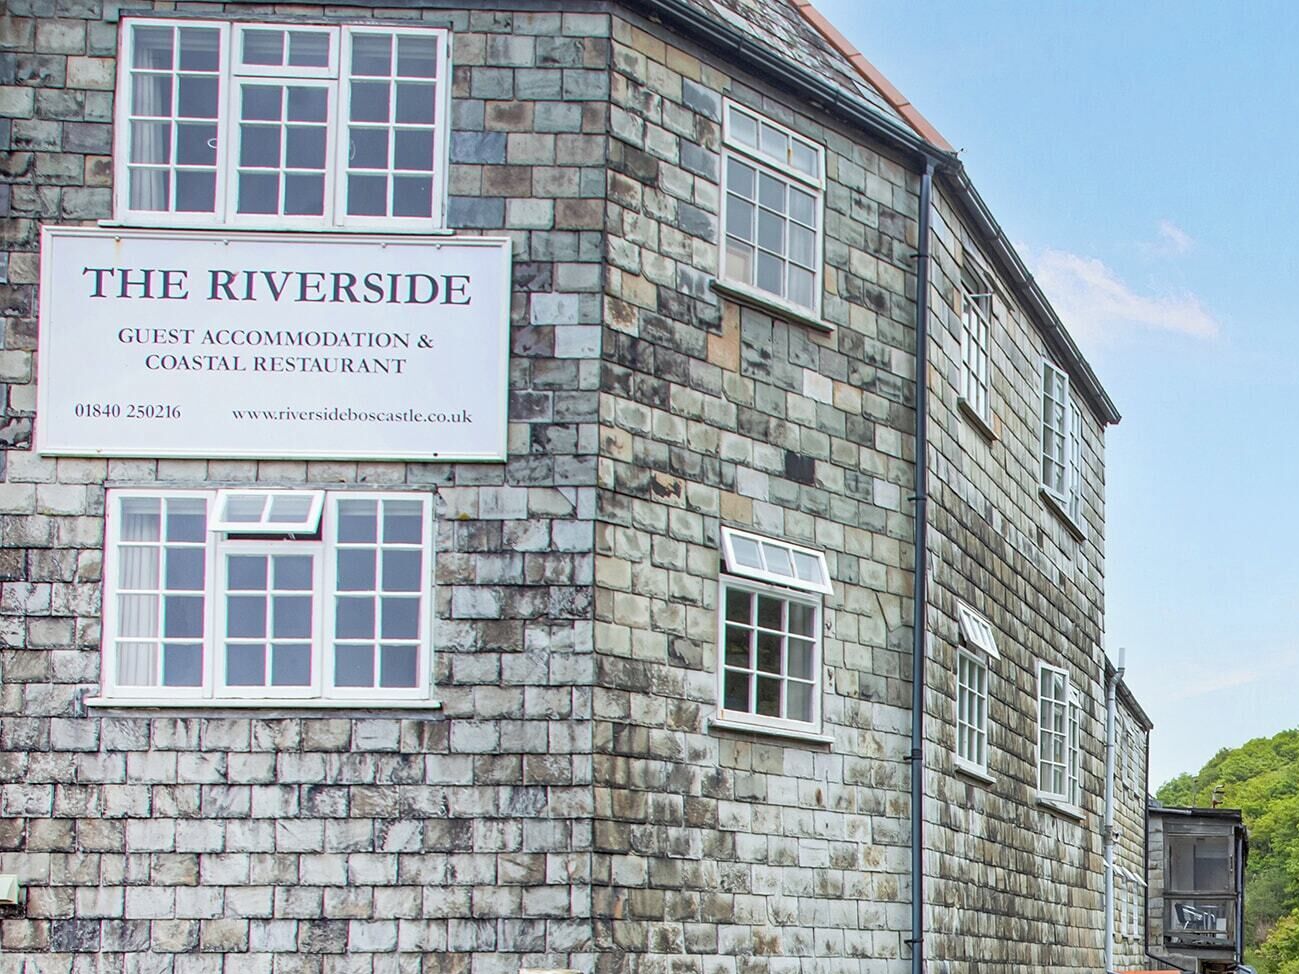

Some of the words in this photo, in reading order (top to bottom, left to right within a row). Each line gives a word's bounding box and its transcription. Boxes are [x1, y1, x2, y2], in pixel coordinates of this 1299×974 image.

[82, 267, 189, 300] THE
[207, 269, 472, 306] RIVERSIDE
[118, 327, 195, 345] GUEST
[201, 329, 410, 349] ACCOMMODATION
[417, 334, 434, 349] &
[145, 354, 246, 372] COASTAL
[253, 356, 406, 374] RESTAURANT
[75, 403, 121, 418] 01840
[126, 404, 182, 419] 250216
[232, 406, 473, 424] www.riversideboscastle.co.uk
